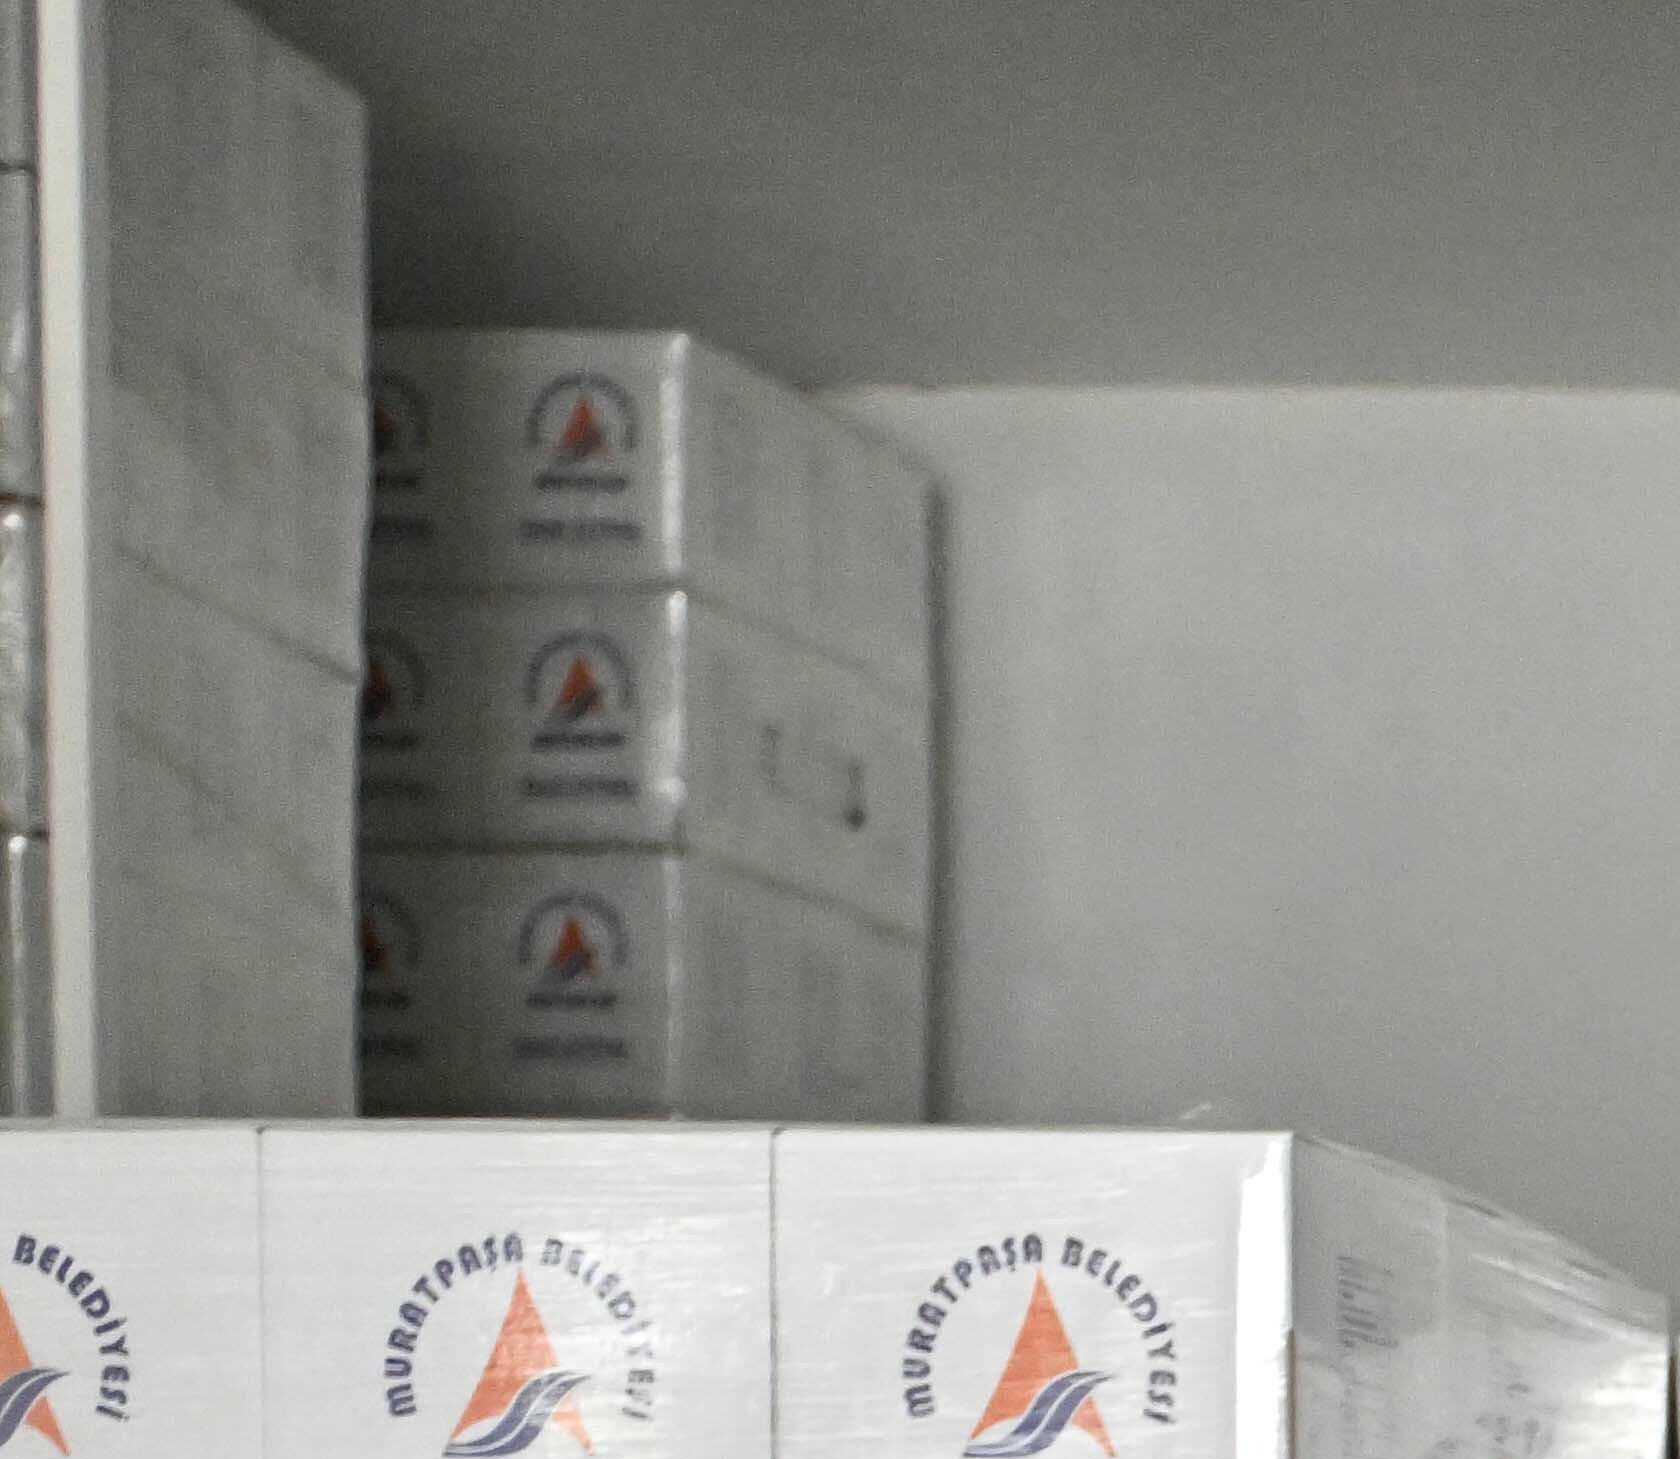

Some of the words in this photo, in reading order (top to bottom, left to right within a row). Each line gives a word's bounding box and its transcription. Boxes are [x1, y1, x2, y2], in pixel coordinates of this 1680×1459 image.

[14, 1234, 130, 1422] BELEDİYESİ
[384, 1232, 523, 1417] MURATPAŞA
[902, 1232, 1043, 1418] MURATPAŞA
[1061, 1237, 1178, 1425] BELEDİYESİ
